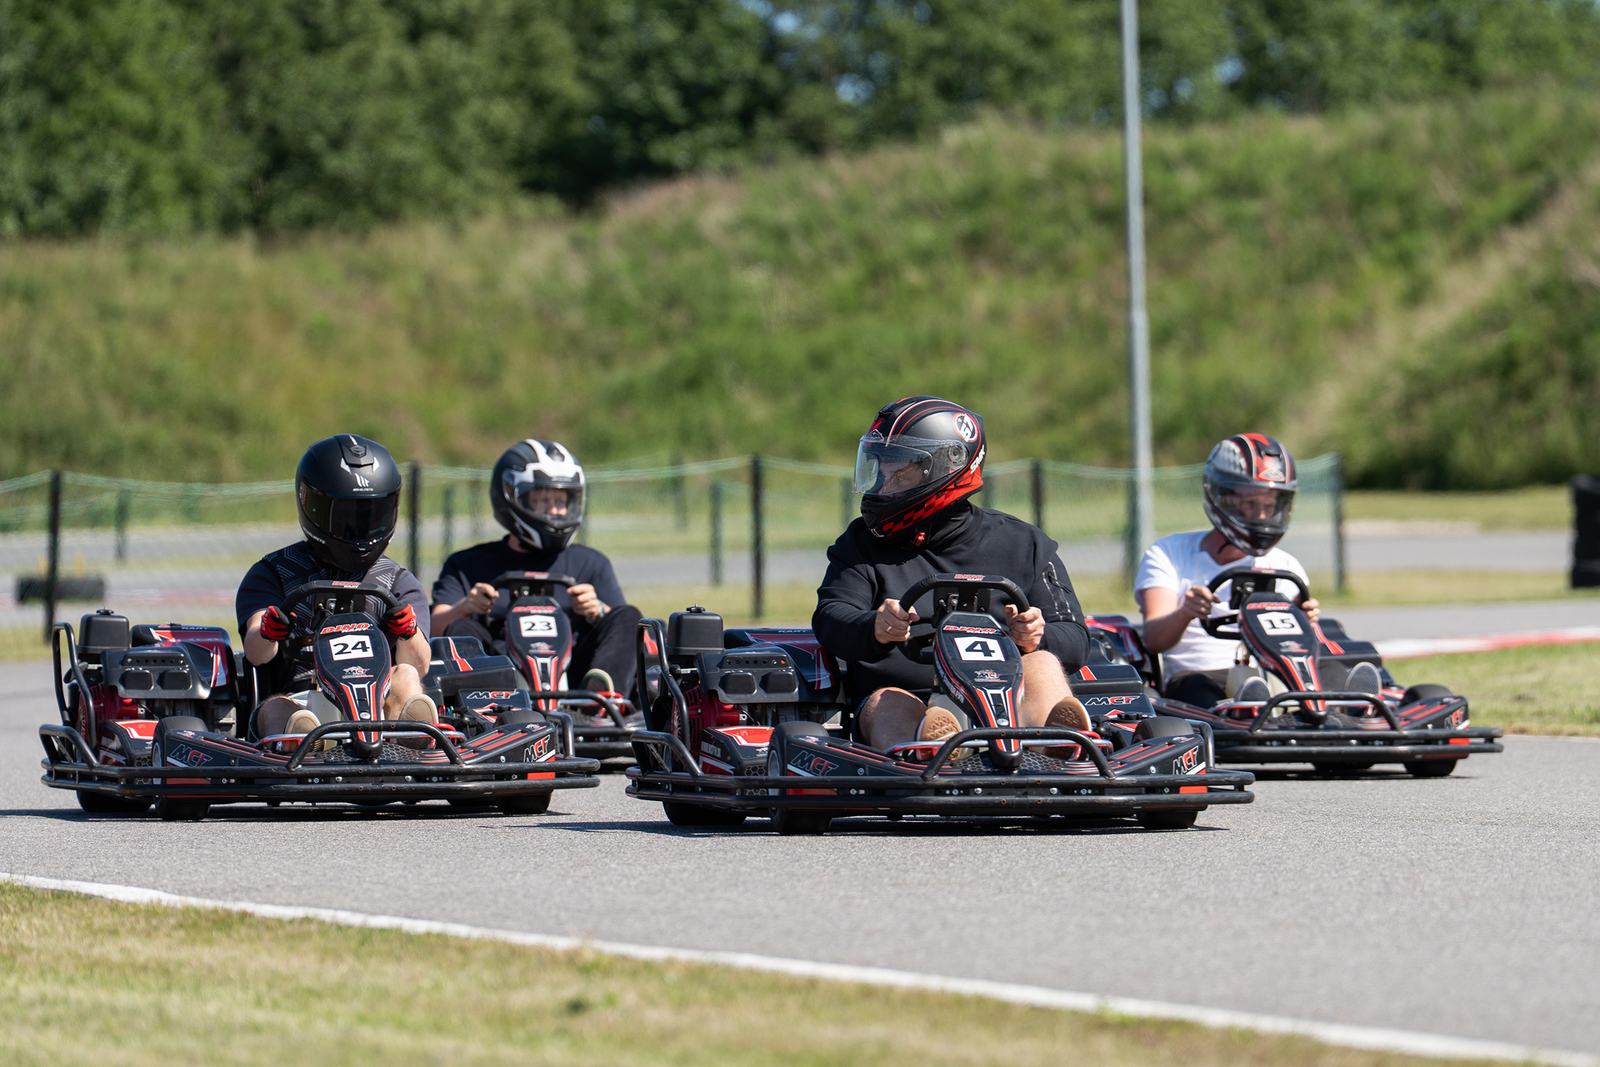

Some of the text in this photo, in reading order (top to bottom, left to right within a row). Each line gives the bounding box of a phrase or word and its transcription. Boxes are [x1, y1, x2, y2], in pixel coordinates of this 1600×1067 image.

[320, 622, 370, 635] DINO
[523, 620, 553, 632] 23
[1264, 618, 1295, 629] 15
[333, 640, 370, 656] 24
[965, 641, 996, 657] 4
